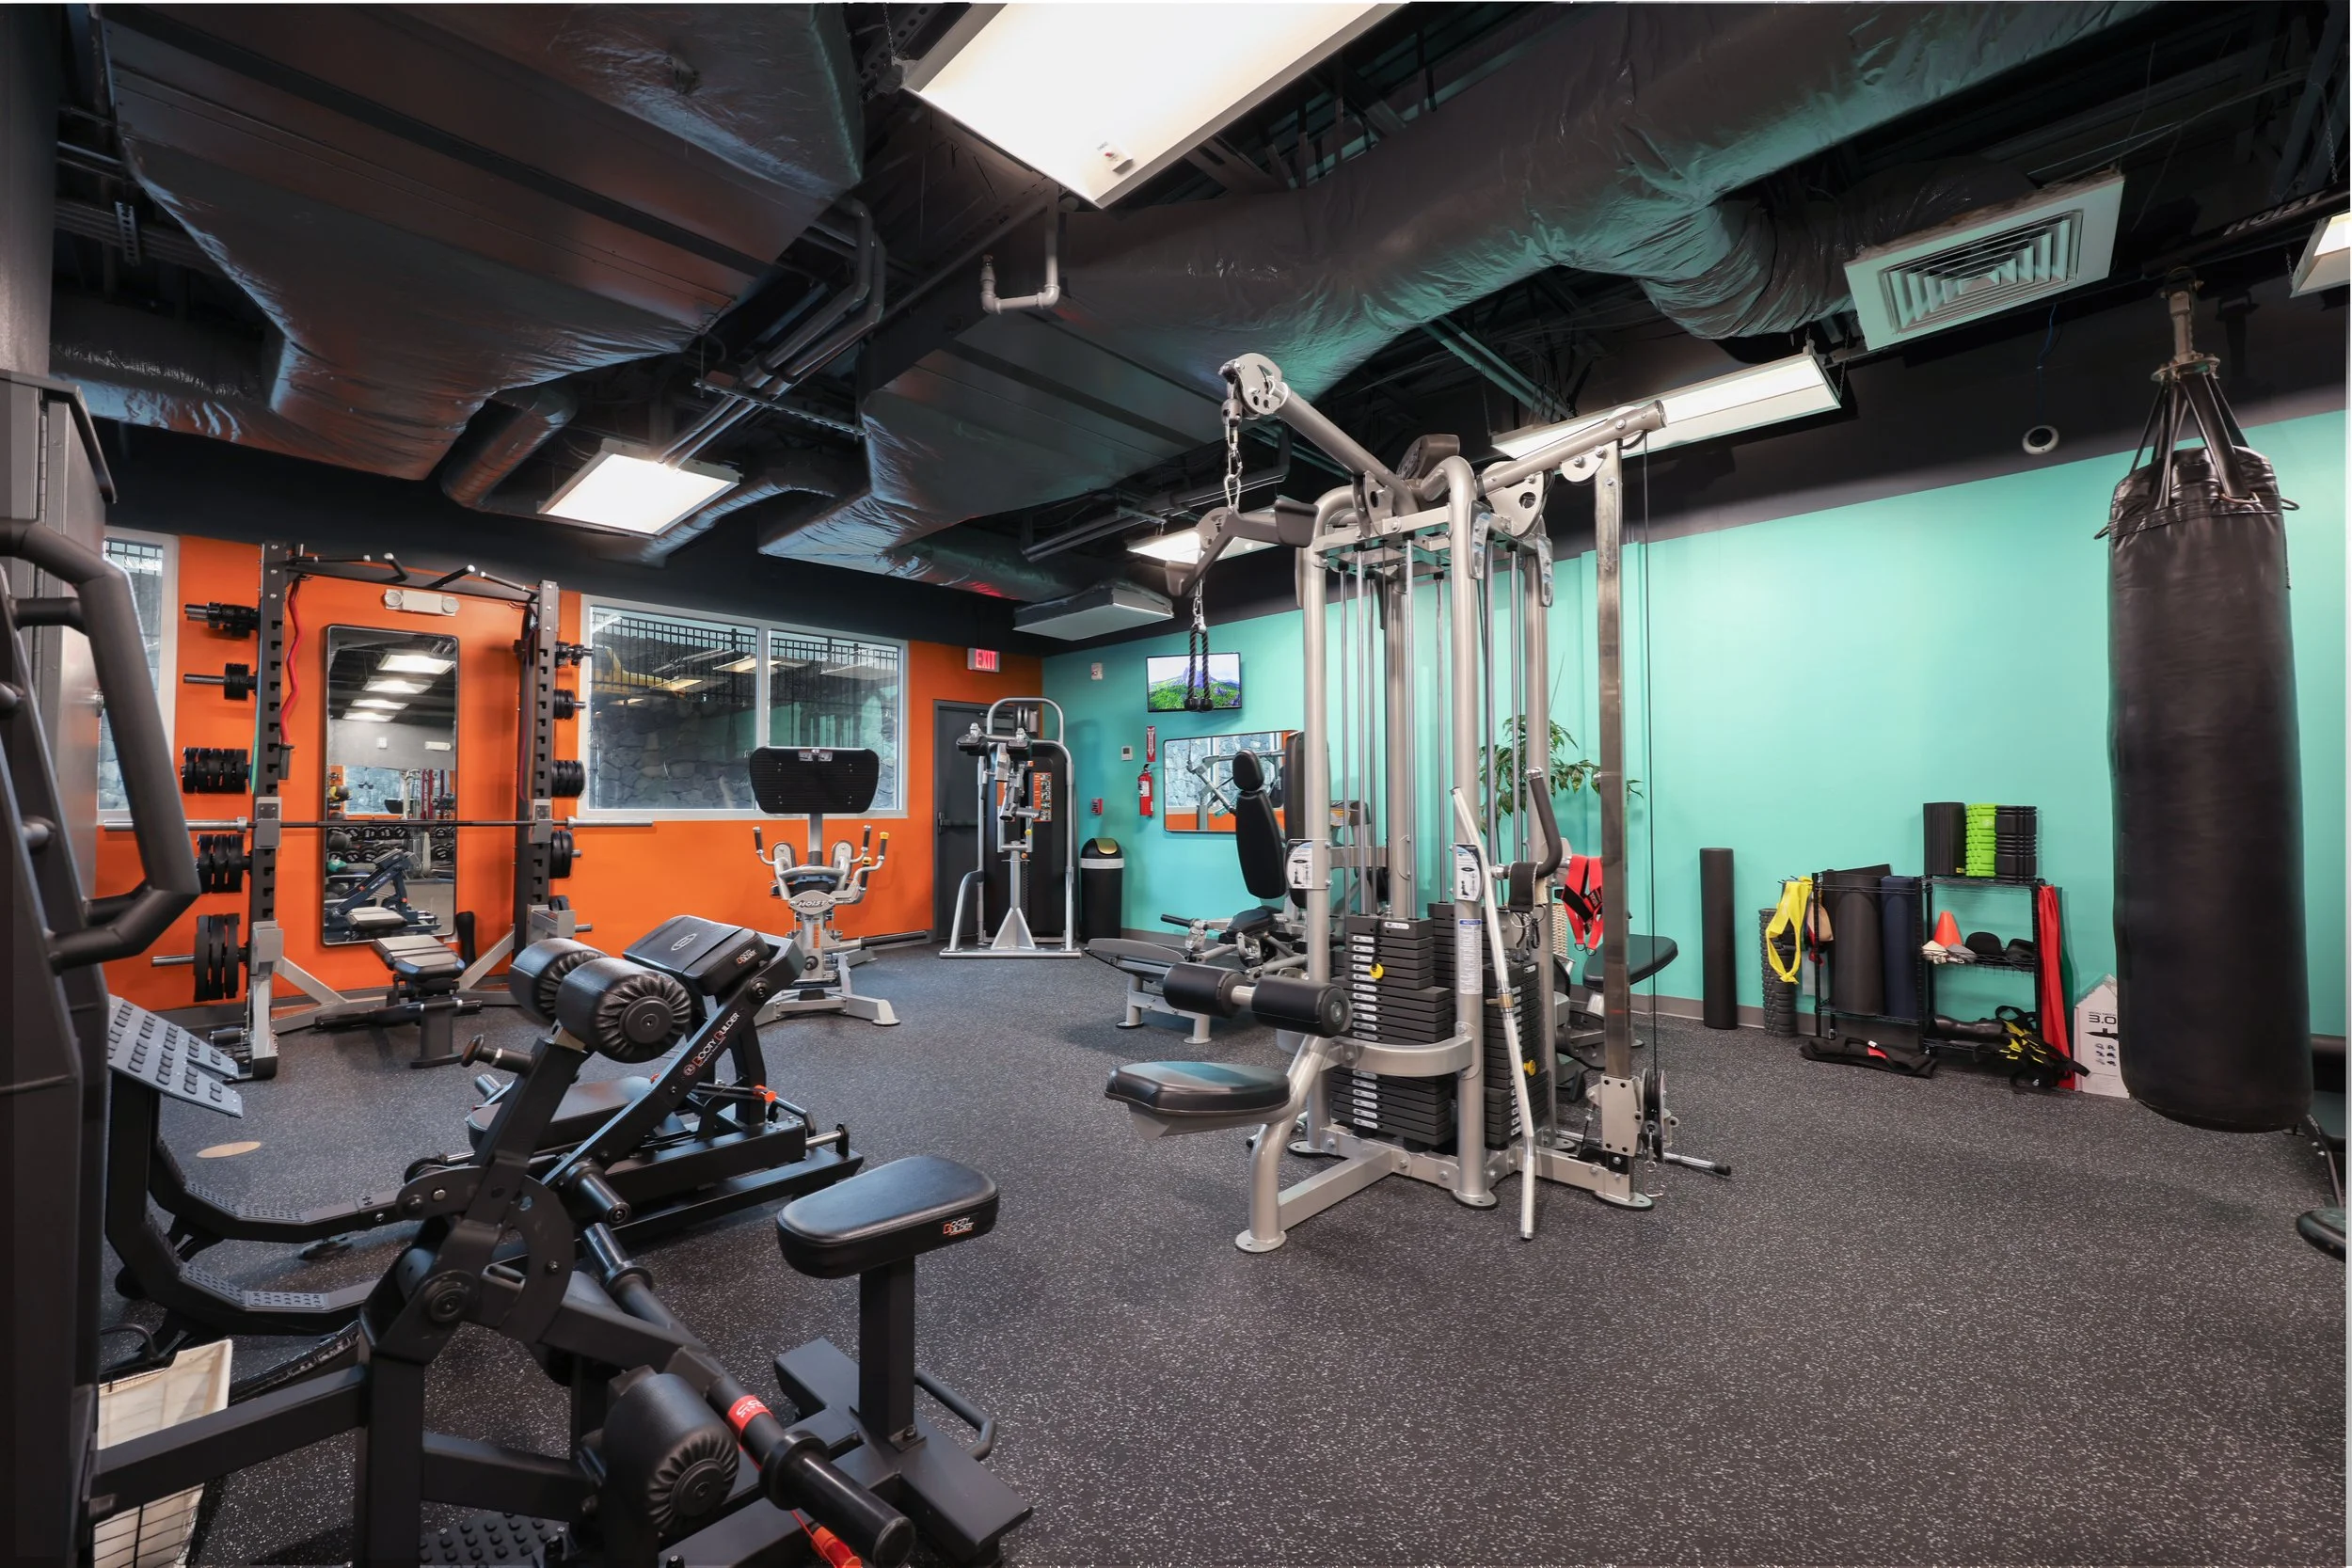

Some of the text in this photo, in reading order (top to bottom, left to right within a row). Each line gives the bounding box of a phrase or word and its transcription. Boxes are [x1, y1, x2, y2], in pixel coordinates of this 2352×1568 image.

[2222, 190, 2328, 235] HOIST
[975, 649, 996, 670] EXIT
[797, 899, 826, 909] HOIST
[2088, 1014, 2117, 1024] 3.0
[691, 1038, 717, 1066] BOOTY
[714, 1012, 740, 1040] BUILDER
